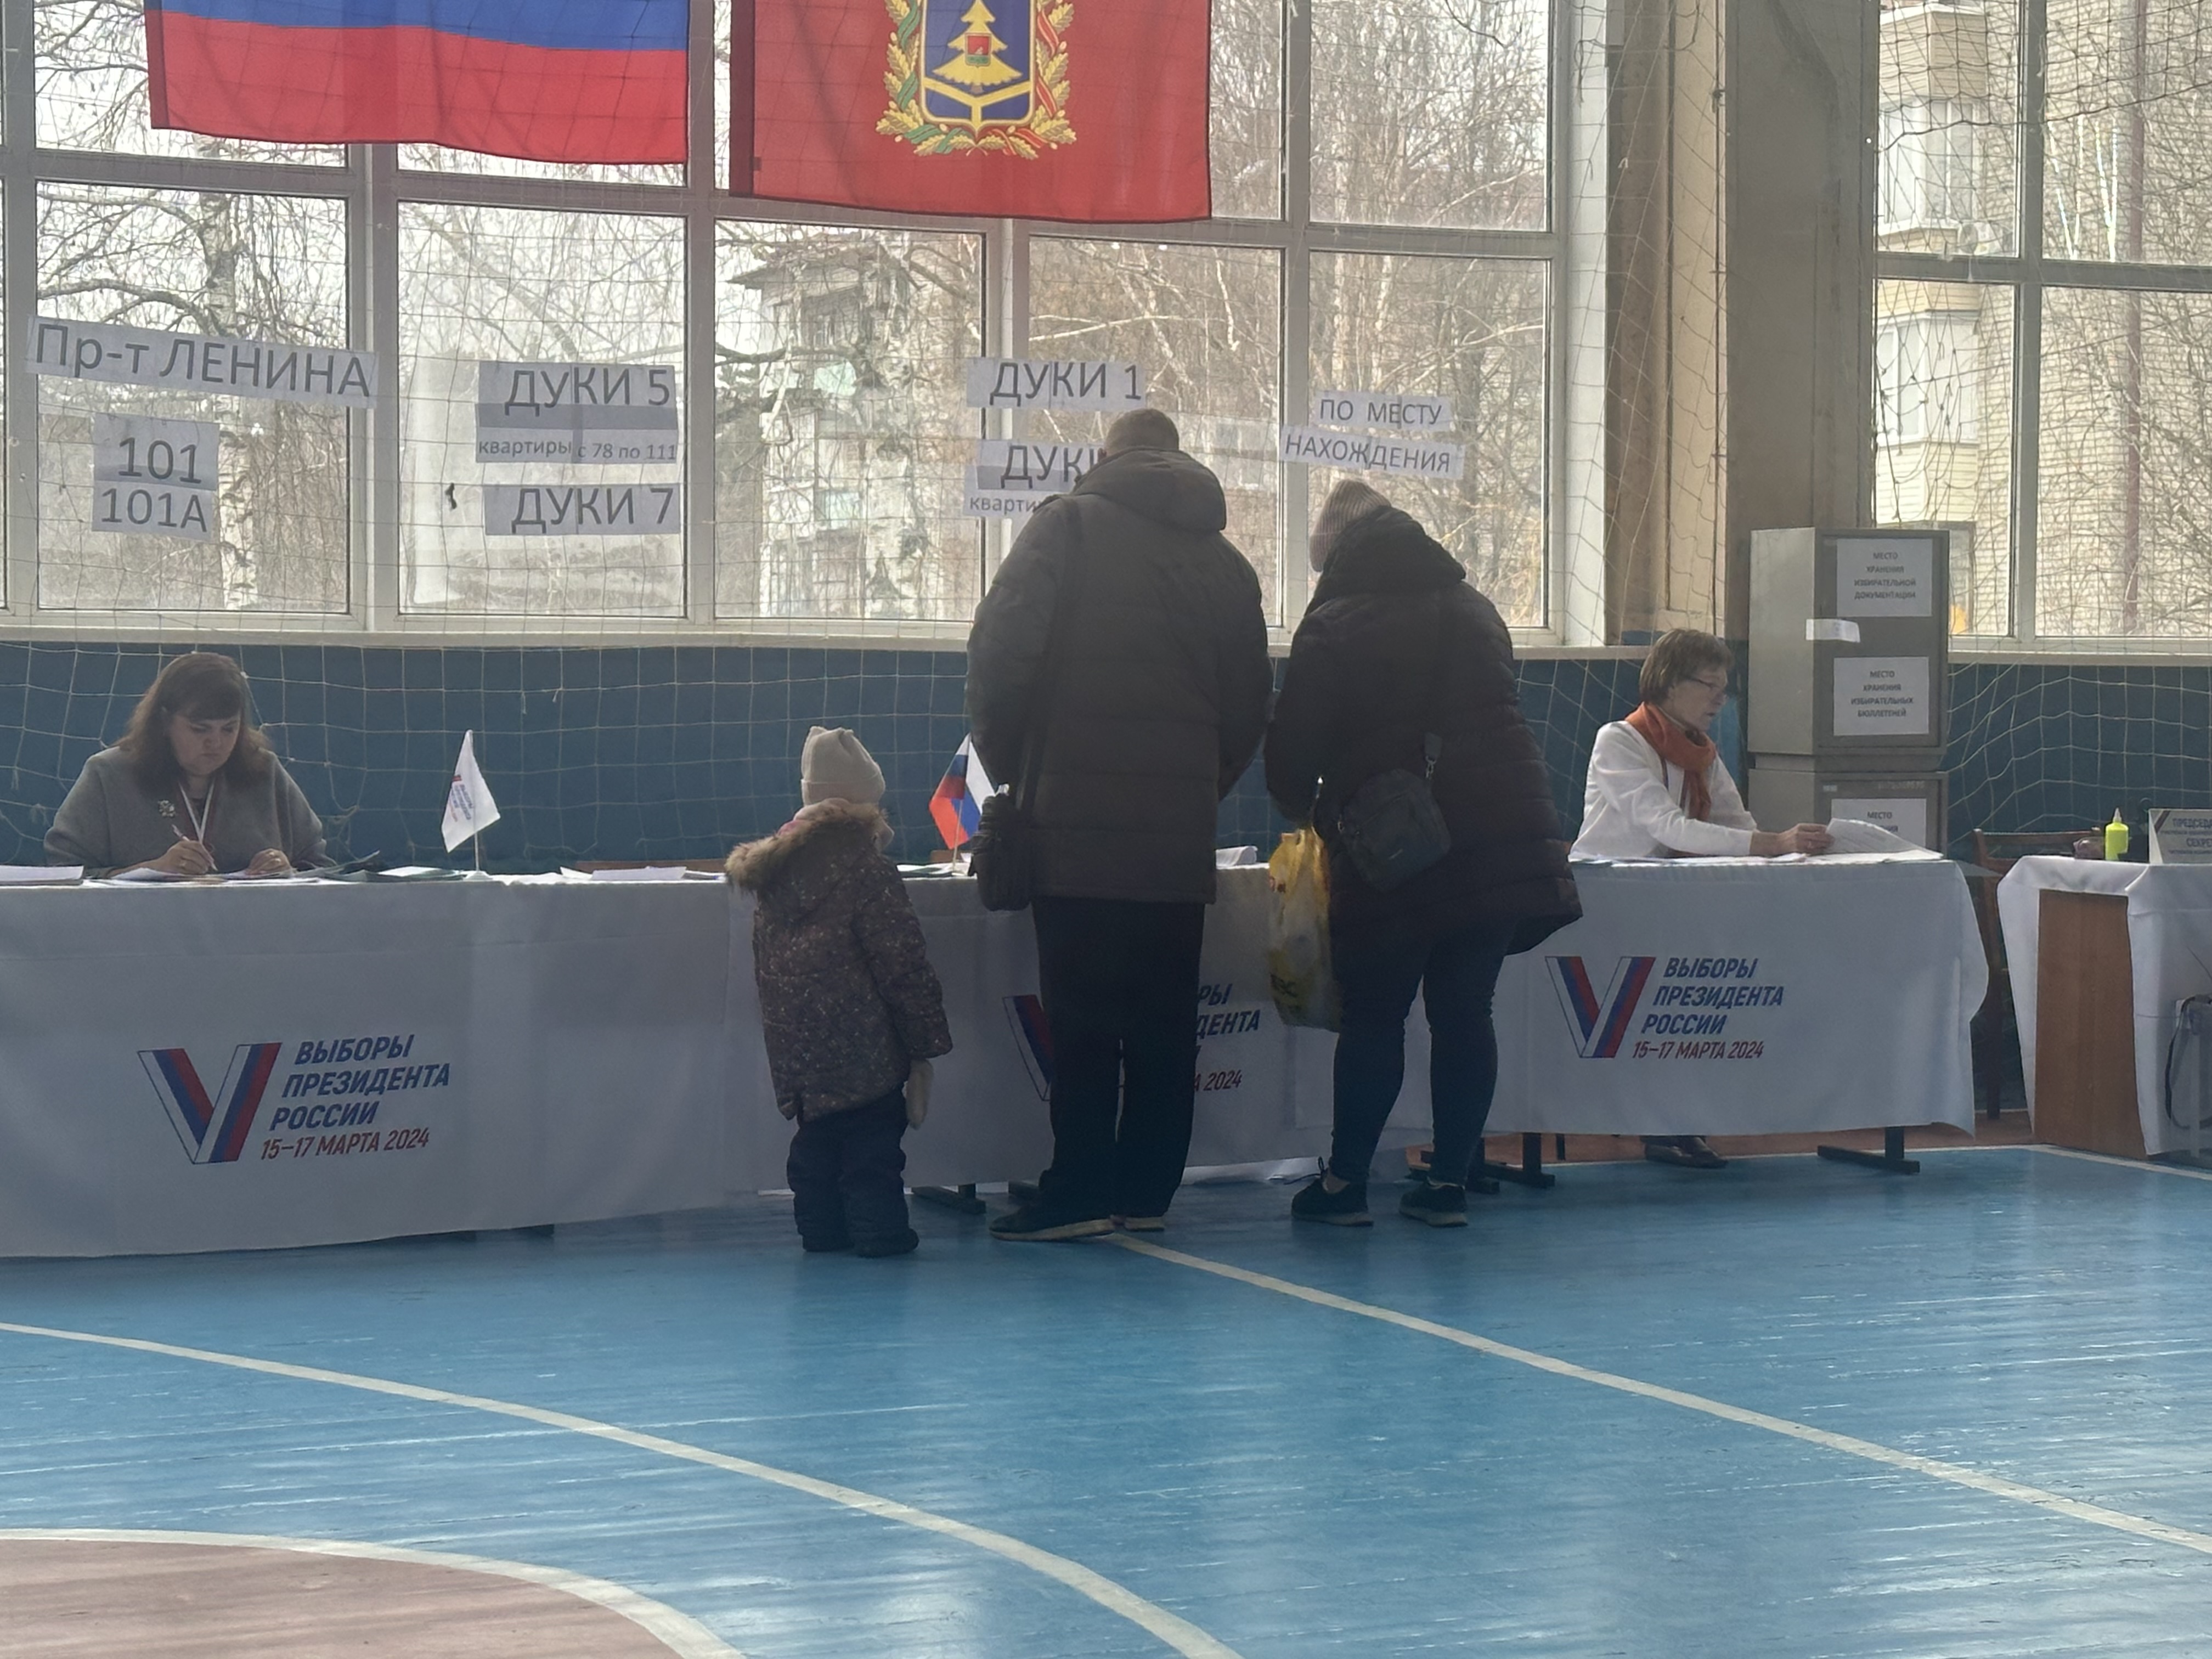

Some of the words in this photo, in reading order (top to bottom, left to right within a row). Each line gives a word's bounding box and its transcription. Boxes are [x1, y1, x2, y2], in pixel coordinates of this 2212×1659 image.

[36, 323, 150, 377] Пр-т
[159, 339, 370, 397] ЛЕНИНА
[504, 367, 630, 417] ДУКИ
[648, 369, 670, 406] 5
[989, 362, 1106, 407] ДУКИ
[1124, 364, 1142, 400] 1
[1320, 399, 1353, 421] ПО
[1367, 402, 1442, 425] МЕСТУ
[119, 437, 202, 484] 101
[478, 440, 572, 458] квартиры
[577, 445, 586, 458] с
[592, 443, 613, 459] 78
[619, 446, 640, 460] по
[646, 443, 676, 460] 111
[1285, 434, 1451, 473] НАХОЖДЕНИЯ
[101, 488, 207, 533] 101А
[511, 487, 634, 534] ДУКИ
[650, 488, 674, 524] 7
[970, 497, 1041, 516] кварти
[1872, 552, 1899, 560] МЕСТО
[1867, 811, 1893, 820] МЕСТО
[1663, 957, 1758, 979] ВЫБОРЫ
[1652, 986, 1785, 1009] ПРЕЗИДЕНТА
[1640, 1014, 1728, 1035] РОССИИ
[294, 1034, 415, 1065] ВЫБОРЫ
[1675, 1041, 1725, 1059] МАРТА
[1726, 1041, 1765, 1059] 2024
[281, 1063, 450, 1098] ПРЕЗИДЕНТА
[1203, 1069, 1243, 1091] 2024
[269, 1101, 380, 1131] РОССИИ
[318, 1132, 381, 1157] МАРТА
[384, 1127, 431, 1150] 2024
